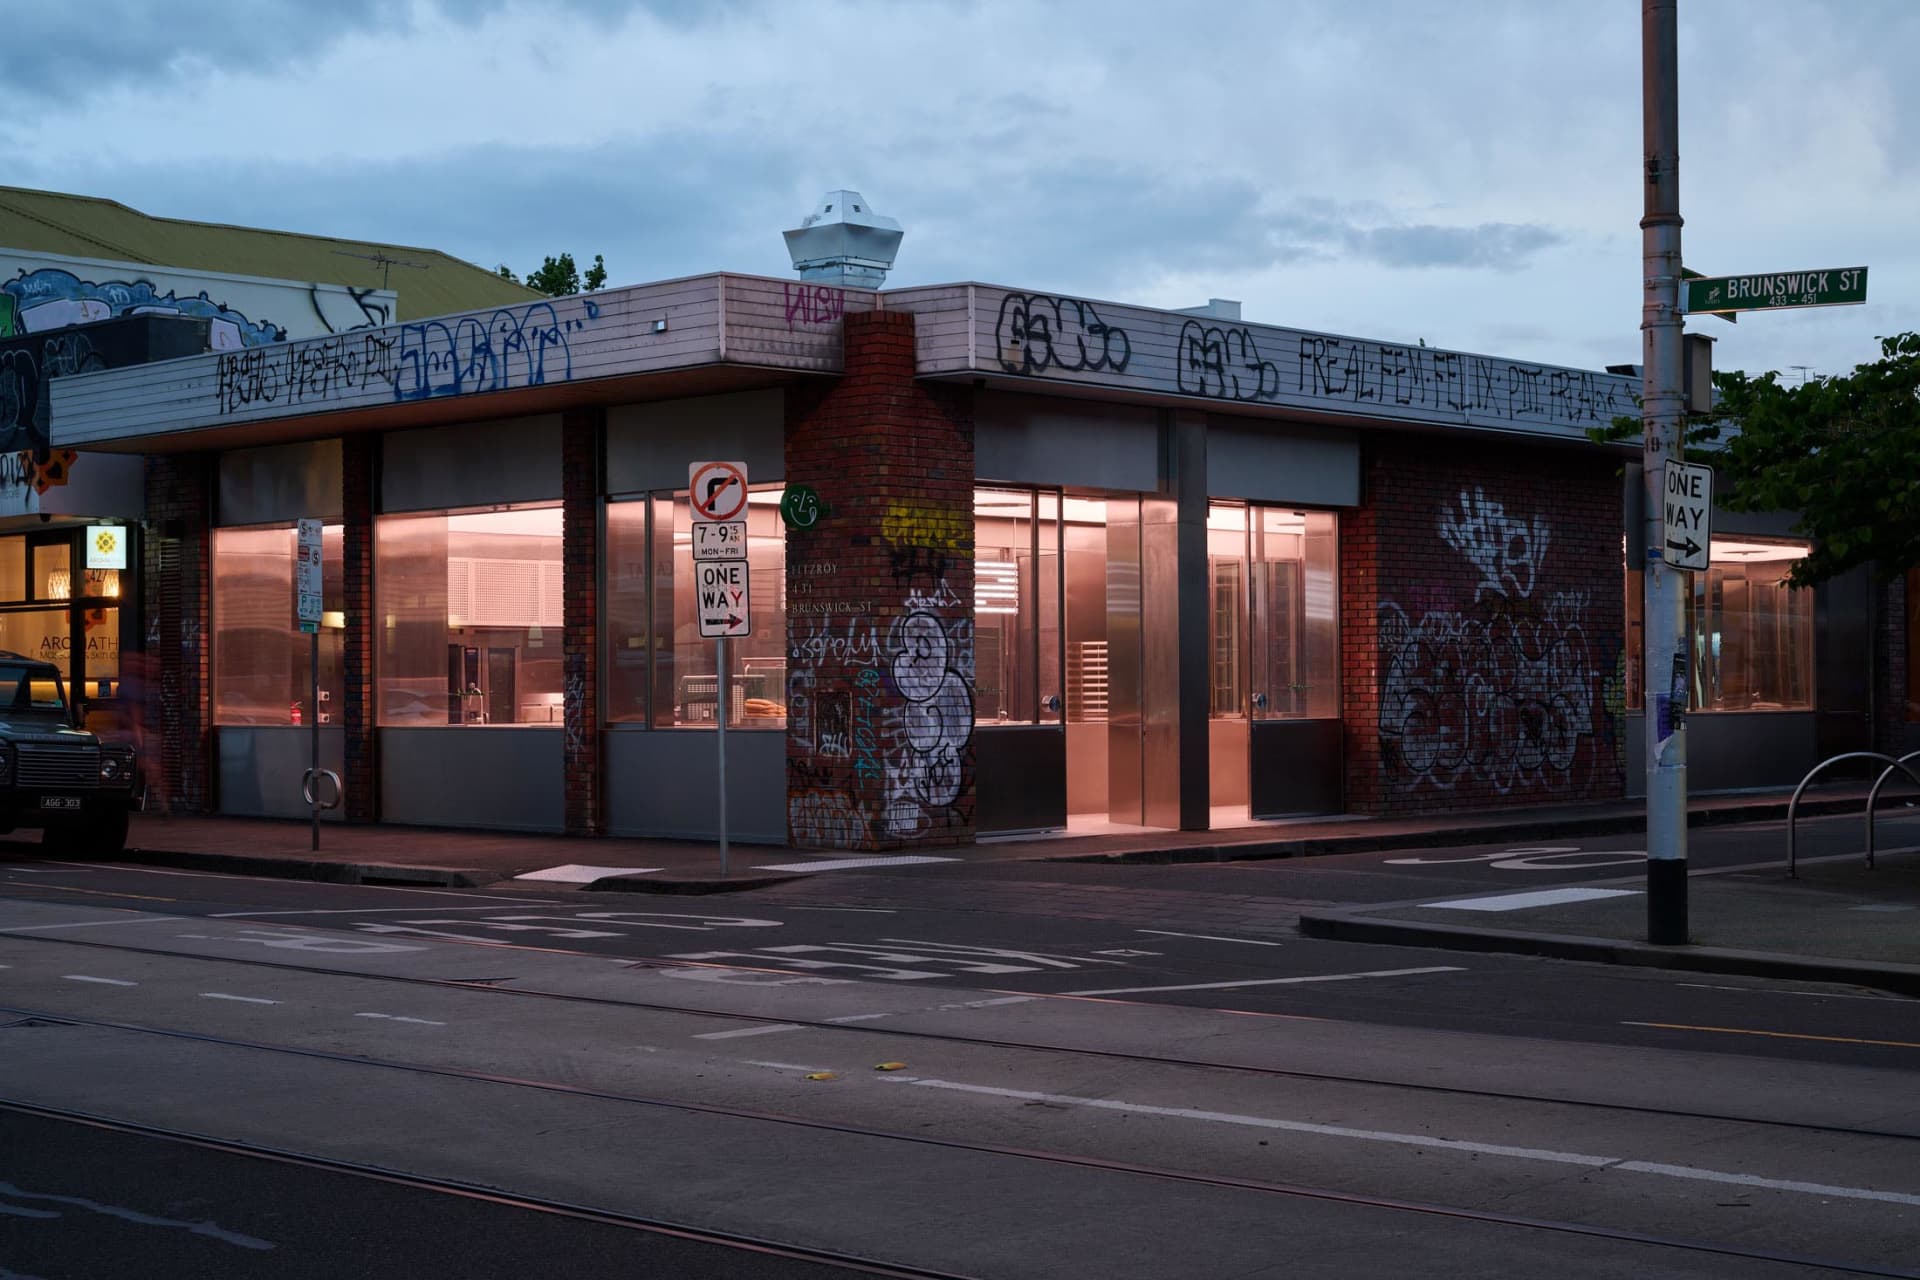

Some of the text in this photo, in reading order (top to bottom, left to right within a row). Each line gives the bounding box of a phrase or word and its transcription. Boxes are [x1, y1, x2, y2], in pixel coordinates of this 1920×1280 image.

[1727, 271, 1861, 299] BRUNSWICK ST
[1769, 296, 1787, 306] 433
[1801, 294, 1817, 305] 451
[1668, 471, 1702, 498] ONE
[1666, 502, 1704, 530] WAY
[704, 568, 740, 585] ONE
[791, 561, 839, 575] FITZROY
[702, 591, 743, 608] WAY
[792, 601, 873, 614] BRUNSWICK ST
